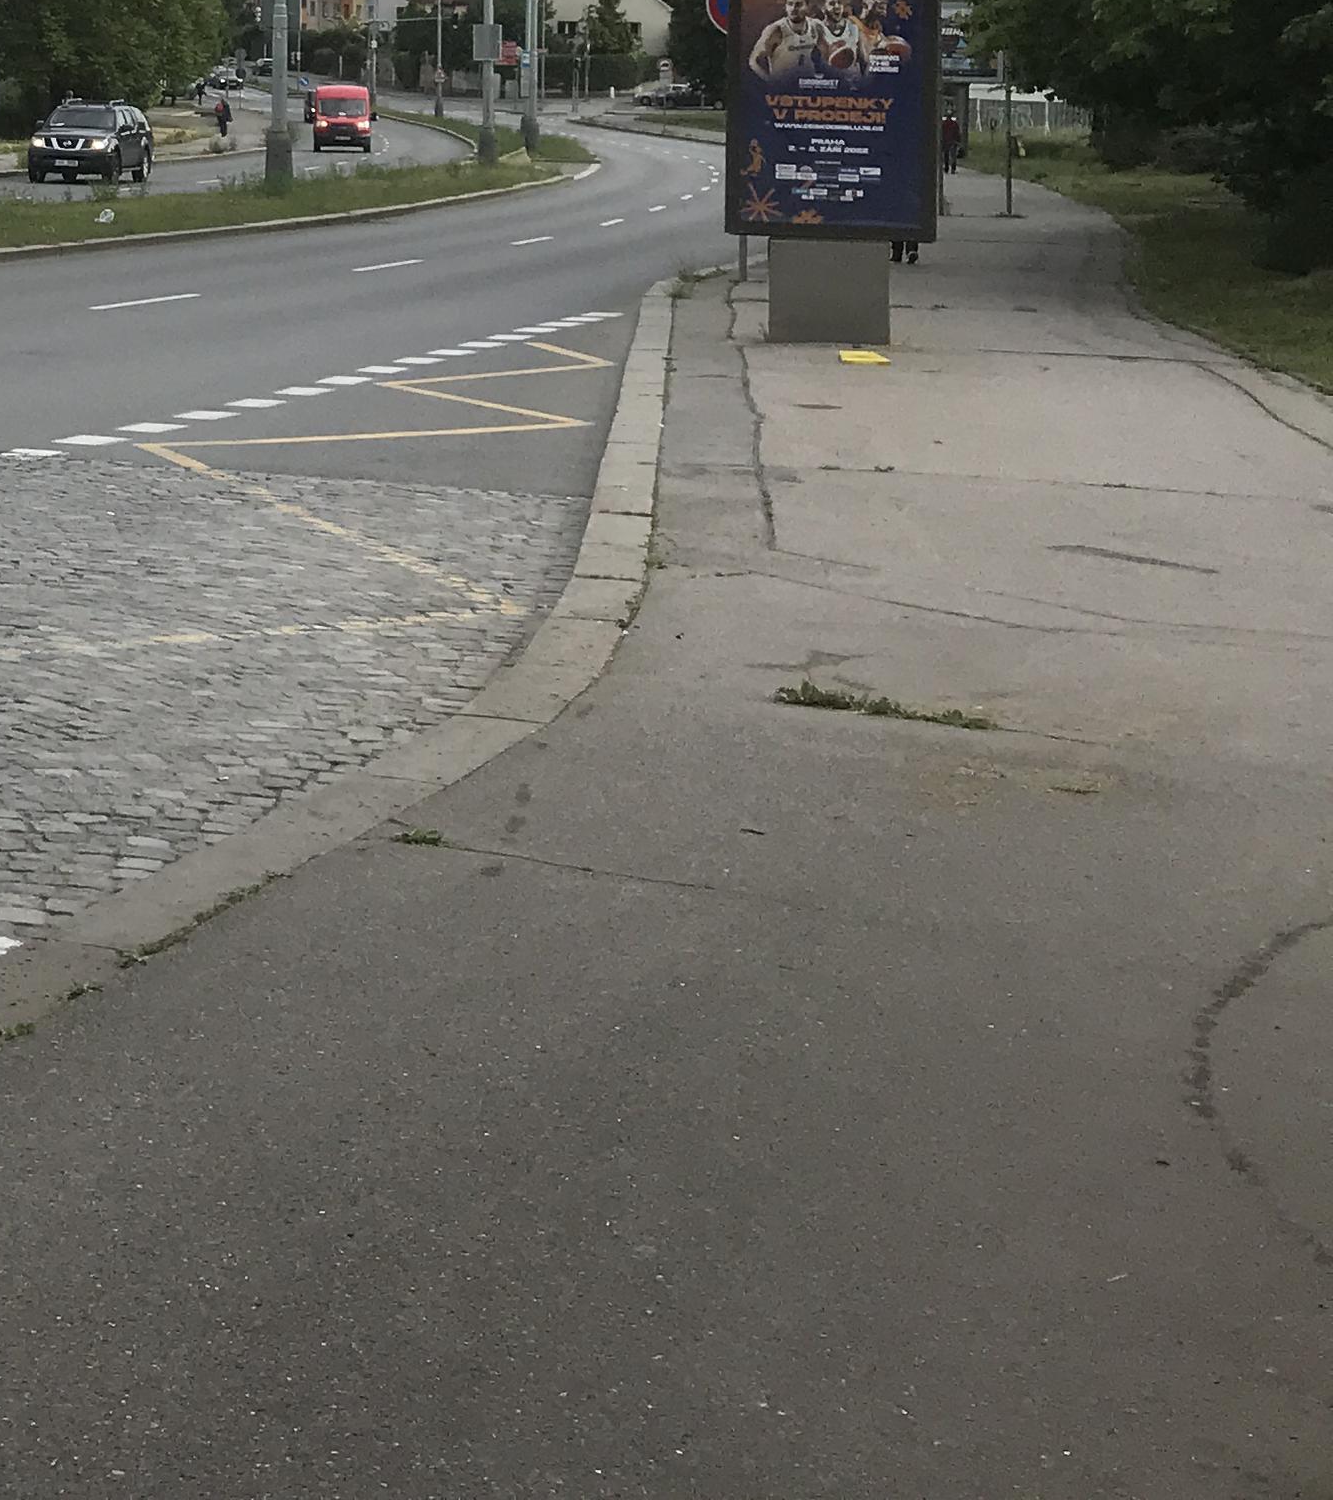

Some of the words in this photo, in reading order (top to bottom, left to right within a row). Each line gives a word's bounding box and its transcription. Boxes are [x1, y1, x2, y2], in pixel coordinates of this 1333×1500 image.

[765, 94, 895, 110] VSTUPENKY
[773, 108, 789, 120] V
[811, 138, 846, 146] PRAHA
